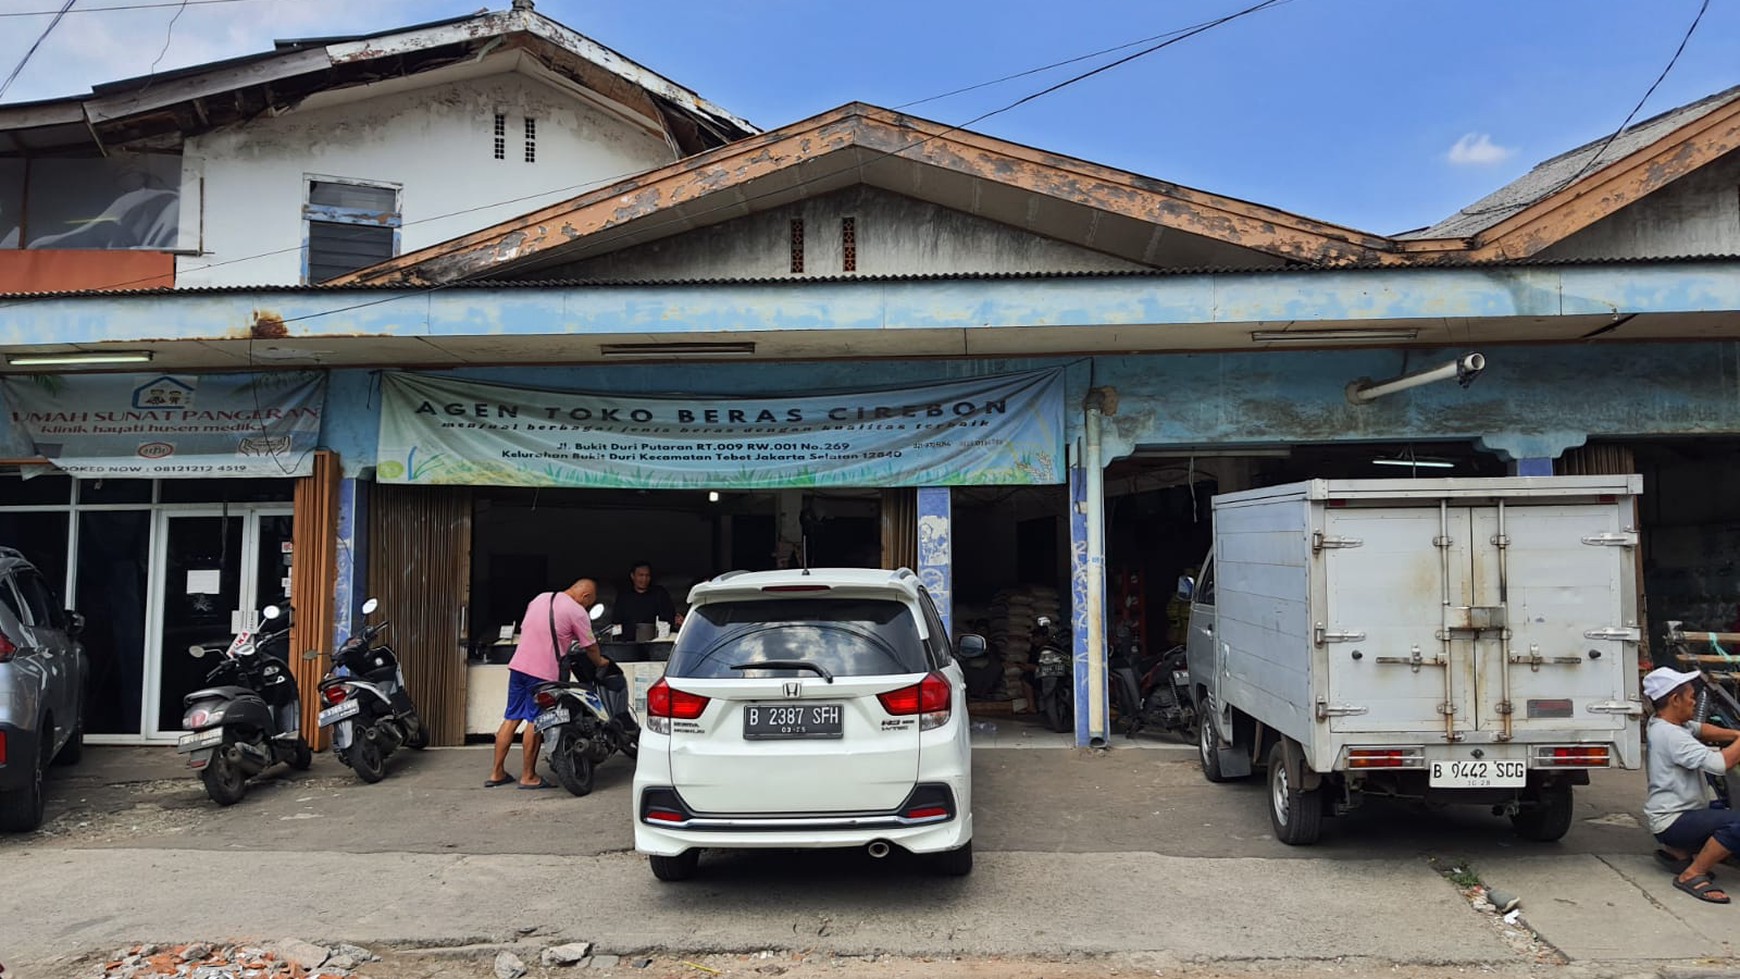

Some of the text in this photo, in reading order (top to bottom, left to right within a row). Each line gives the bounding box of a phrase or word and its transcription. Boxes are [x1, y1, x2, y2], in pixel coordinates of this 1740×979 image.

[12, 407, 321, 422] UMAH SUNAT PANGERAN
[415, 399, 1006, 423] AGEN TOKO BERAS CIREBON
[41, 425, 88, 433] klinik
[92, 424, 144, 434] hayati
[148, 424, 199, 432] husen
[441, 422, 518, 430] menjual
[527, 423, 613, 432] berbagai
[575, 442, 607, 450] Bukit
[611, 442, 638, 450] Duri
[641, 442, 693, 451] Putaran
[696, 443, 743, 451] RT.009
[747, 443, 797, 451] RW.001
[801, 442, 849, 451] No.269
[502, 450, 568, 459] Kelurahan
[572, 452, 605, 460] Bukit
[609, 453, 636, 461] Duri
[639, 453, 712, 461] Kecamatan
[715, 453, 751, 461] Tebet
[754, 453, 805, 461] Jakarta
[809, 452, 859, 461] Selatan
[749, 706, 839, 725] B 2387 SFH
[1433, 762, 1524, 778] B 9442 SCG
